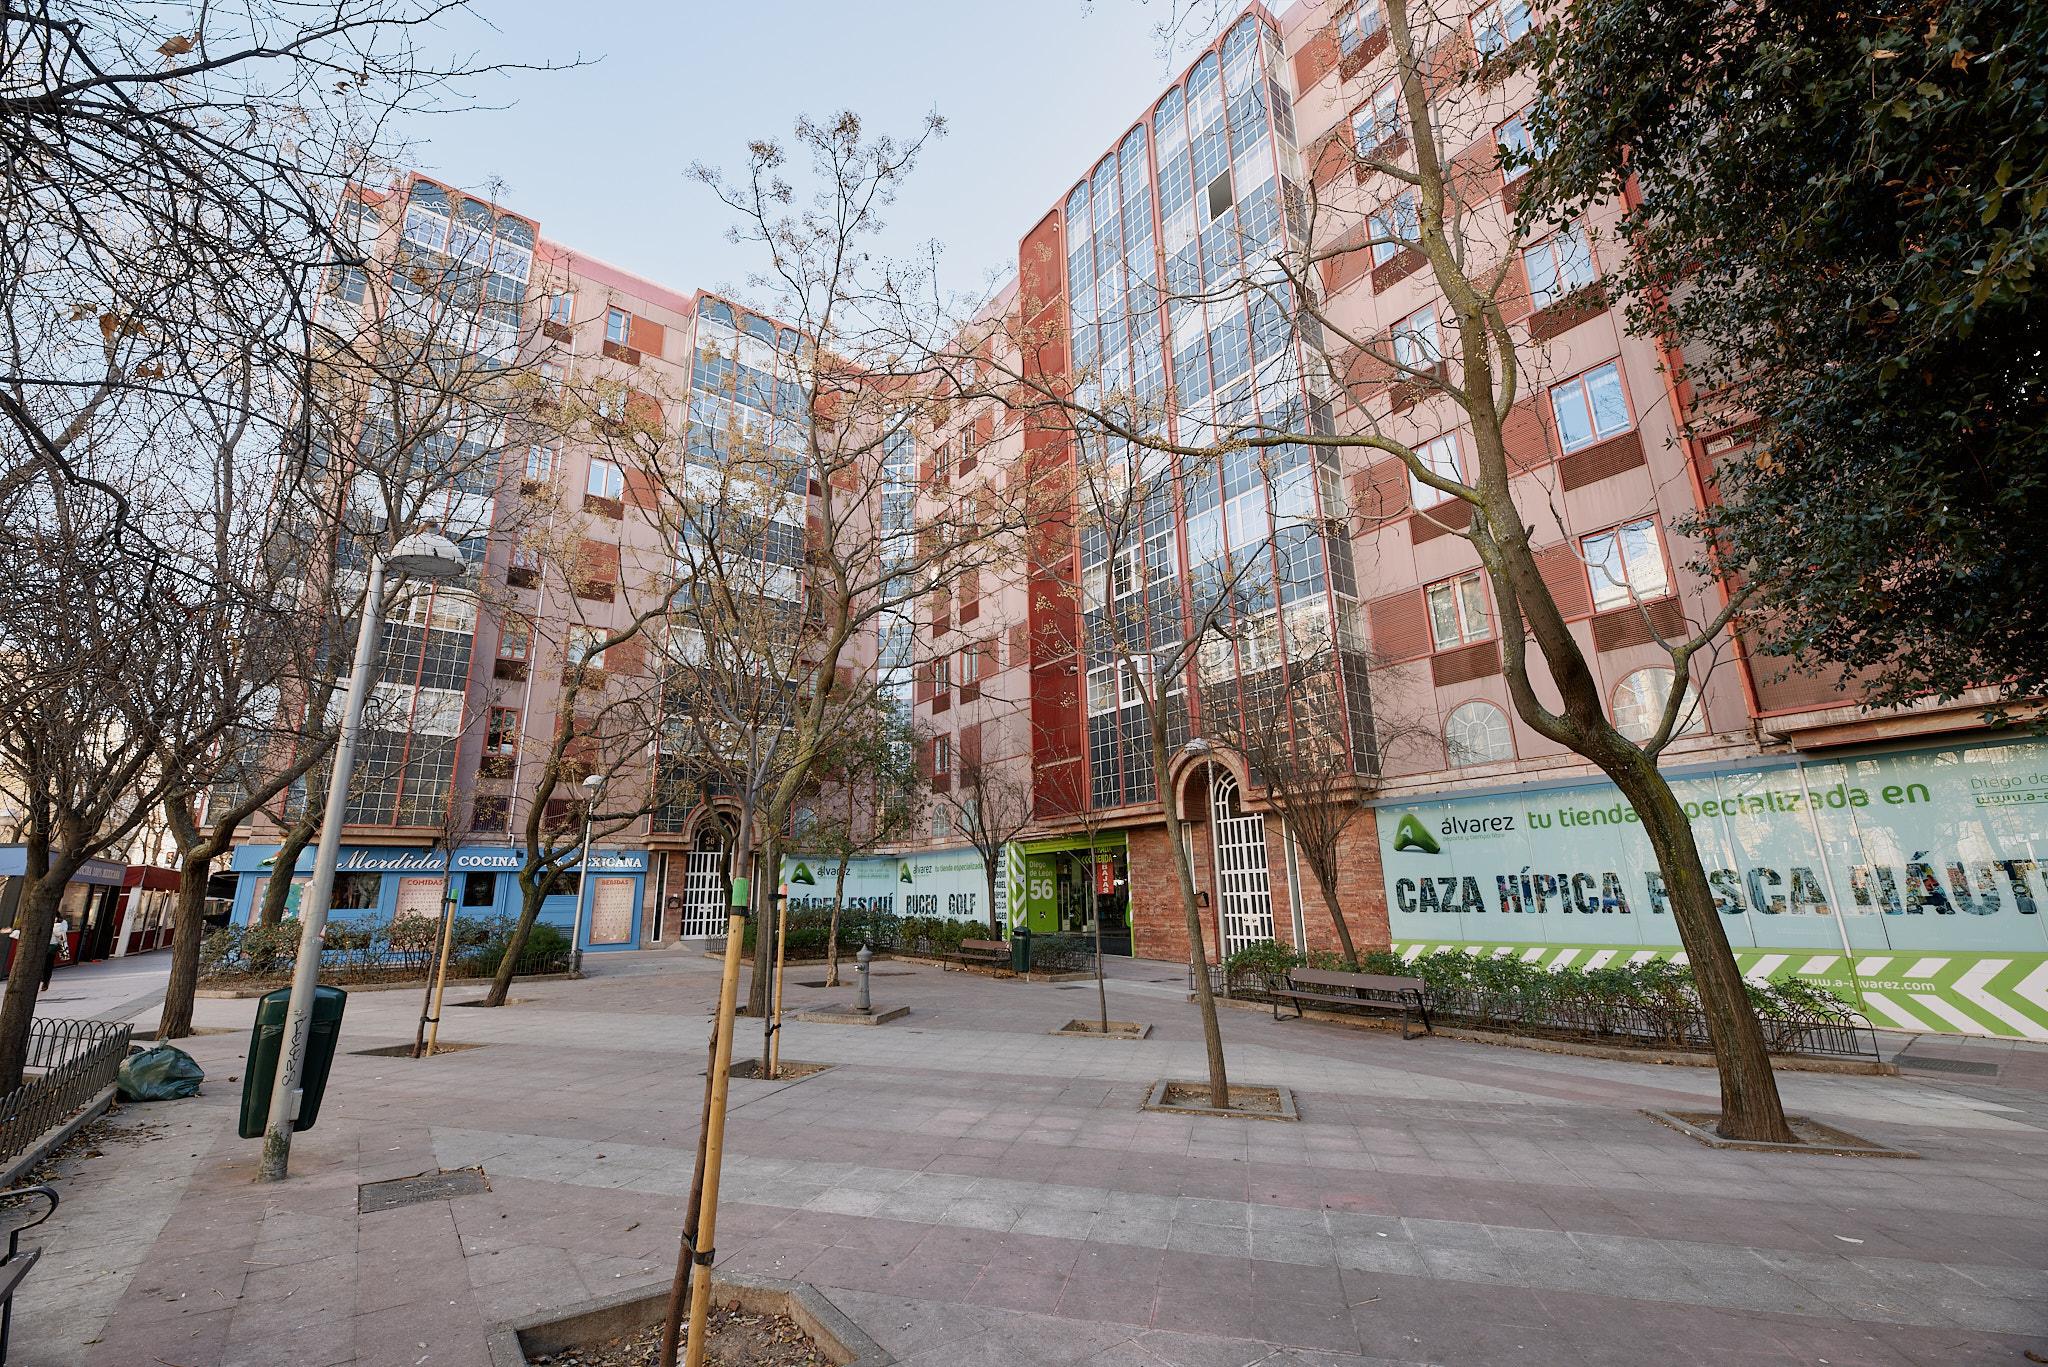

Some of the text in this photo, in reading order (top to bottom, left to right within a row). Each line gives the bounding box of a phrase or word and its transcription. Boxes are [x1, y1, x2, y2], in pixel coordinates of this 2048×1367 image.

[1971, 777, 2022, 789] Diego
[1441, 784, 1930, 835] álvarez tu tienda pecializada en
[337, 850, 446, 869] Mordida
[458, 856, 519, 867] COCINA
[1029, 861, 1047, 869] Diego
[1029, 869, 1038, 877] de
[1030, 879, 1054, 900] 56
[1396, 876, 1487, 913] CAZA
[1496, 865, 1631, 914] HÍPICA
[1645, 867, 1832, 915] PSCA
[906, 893, 976, 915] BUCEO GOLF
